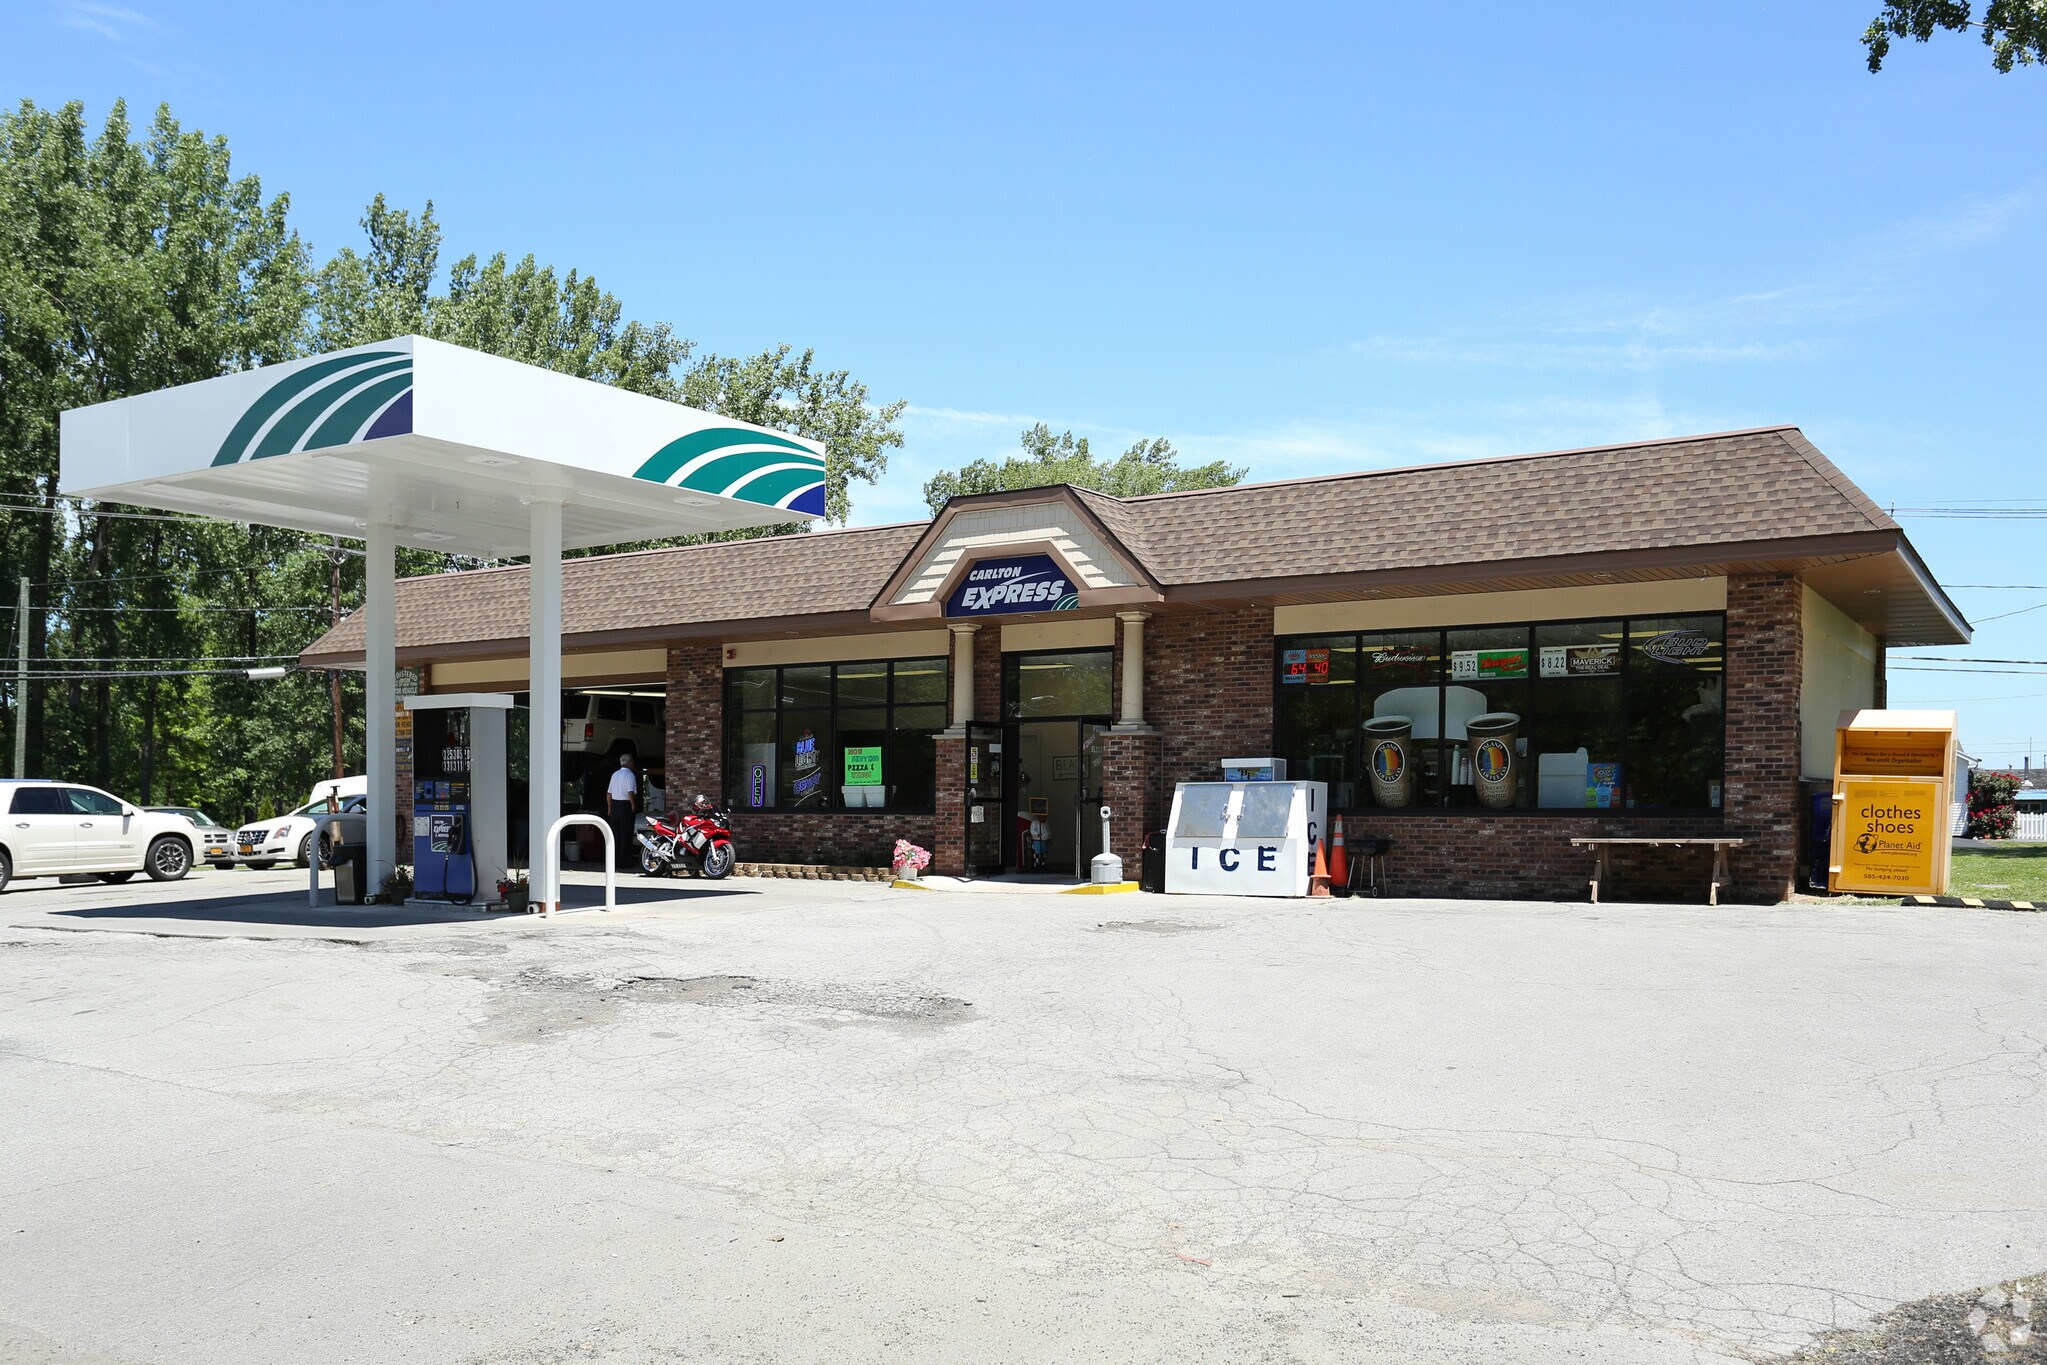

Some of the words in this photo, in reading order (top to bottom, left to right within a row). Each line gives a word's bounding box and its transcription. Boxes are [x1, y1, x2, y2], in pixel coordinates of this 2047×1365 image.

[969, 566, 1022, 581] CARLTON
[961, 580, 1065, 610] EXPRESS
[1663, 637, 1708, 647] BUD
[1651, 646, 1709, 656] LIGHT
[1372, 652, 1427, 663] Budweiser
[1547, 657, 1565, 668] 8.22
[1572, 657, 1613, 666] MAVERICK
[1291, 663, 1306, 675] 64
[1314, 661, 1329, 674] 40
[1459, 661, 1476, 672] 9.52
[1378, 743, 1398, 752] ISLAND
[1482, 741, 1503, 751] ISLAND
[1861, 804, 1921, 819] clothes
[1867, 819, 1914, 834] shoes
[1879, 840, 1904, 849] Planet
[1906, 842, 1921, 850] Aid
[1192, 846, 1277, 871] ICE
